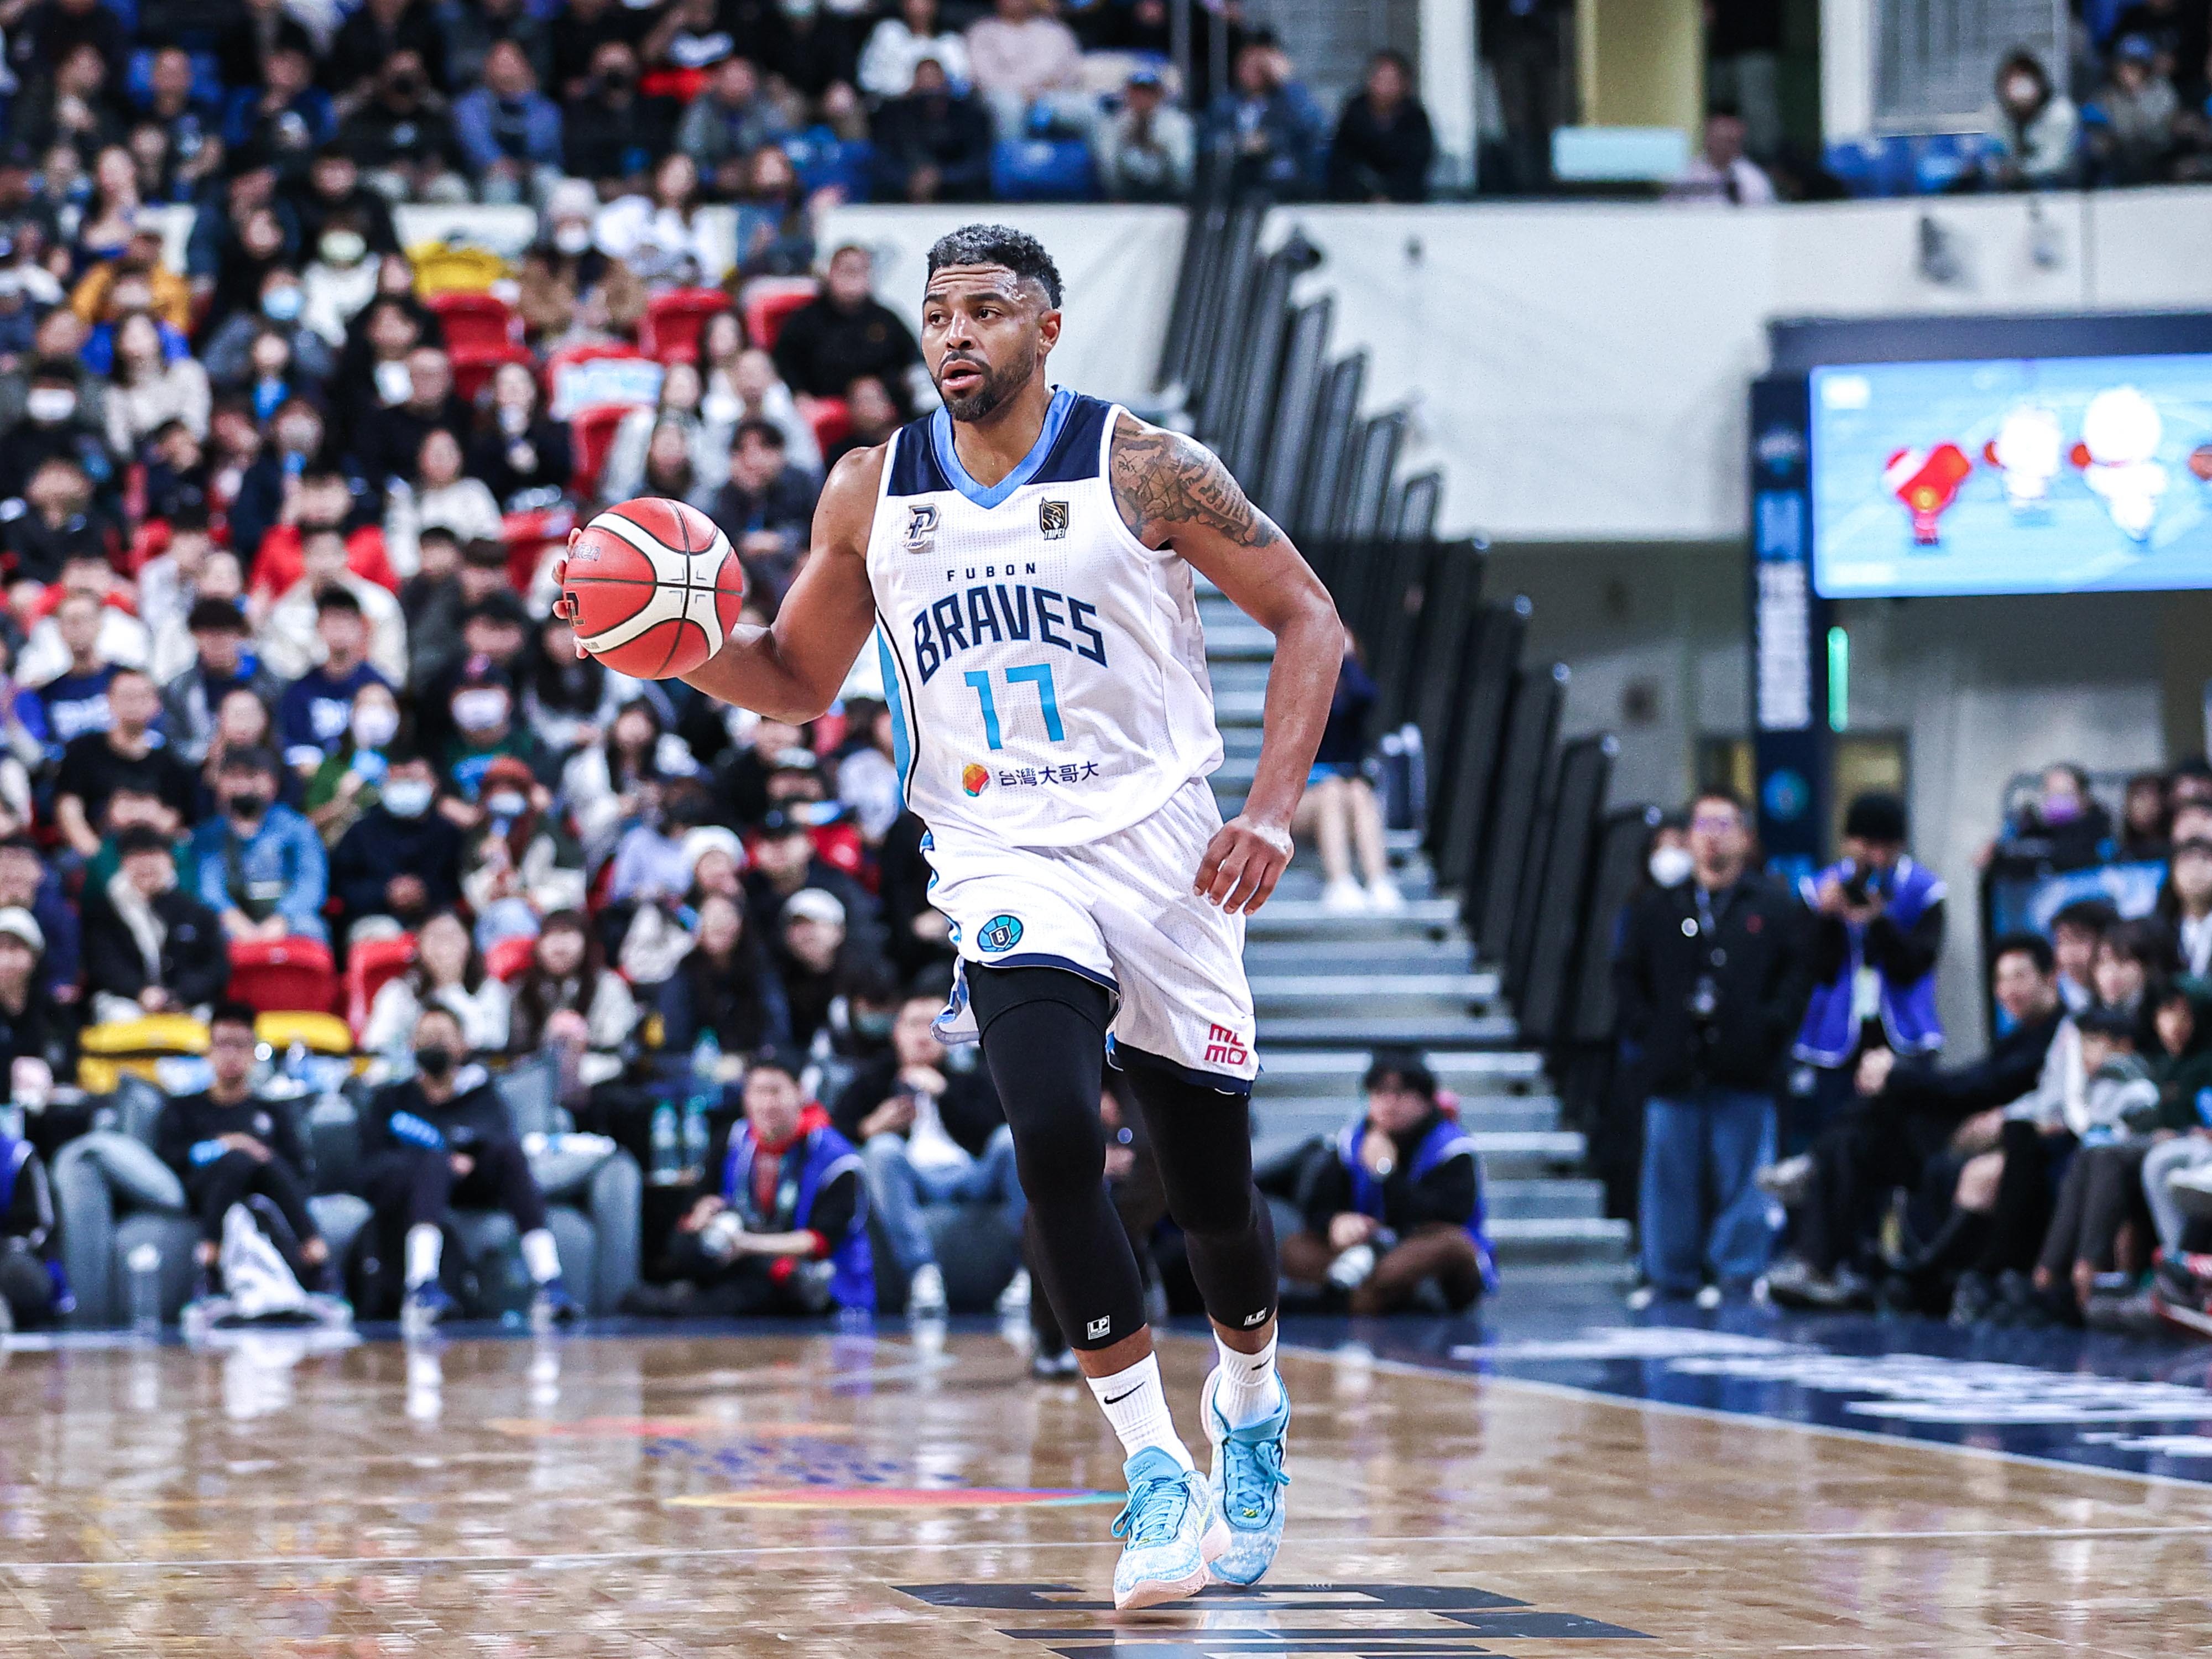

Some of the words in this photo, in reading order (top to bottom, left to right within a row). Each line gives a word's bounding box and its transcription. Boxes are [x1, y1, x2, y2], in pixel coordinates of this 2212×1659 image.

[1044, 527, 1066, 540] TAIPEI
[947, 562, 1036, 582] FUBON
[914, 584, 1108, 686] BRAVES
[964, 663, 1065, 751] 17
[998, 760, 1099, 787] 台灣大哥大
[1089, 1318, 1108, 1333] LP
[1248, 1309, 1265, 1322] LP
